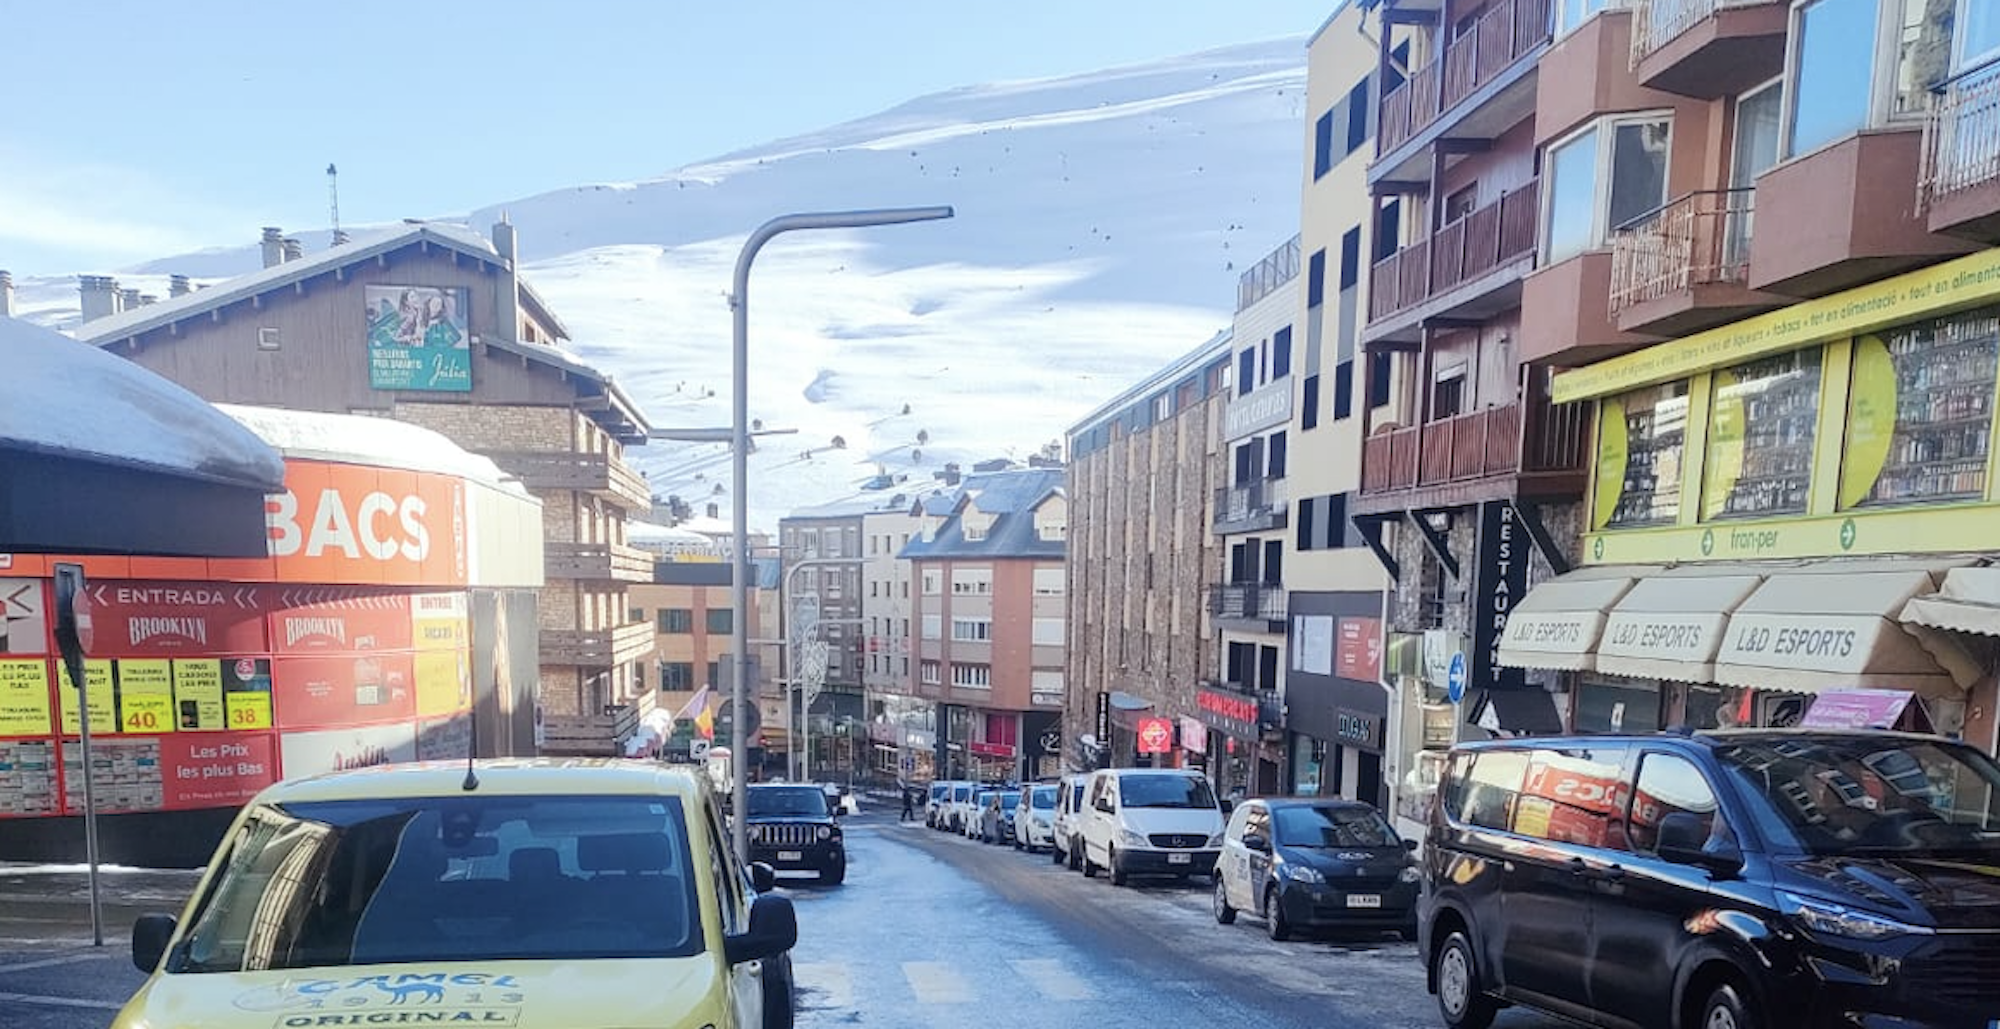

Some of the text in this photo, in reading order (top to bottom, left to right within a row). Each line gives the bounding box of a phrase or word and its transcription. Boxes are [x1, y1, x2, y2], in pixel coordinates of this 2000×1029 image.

[1935, 280, 1948, 294] en
[117, 587, 226, 605] ENTRADA
[128, 616, 207, 646] BROOKLYN
[285, 617, 345, 647] BROOKLYN
[1535, 622, 1581, 642] ESPORTS
[1612, 623, 1702, 648] L&D ESPORTS
[1736, 626, 1856, 657] L&D ESPORTS
[190, 742, 250, 758] Les Prix
[176, 762, 264, 780] les plus Bas
[298, 973, 520, 994] CAMEL
[285, 1011, 507, 1027] ORIGINAL
